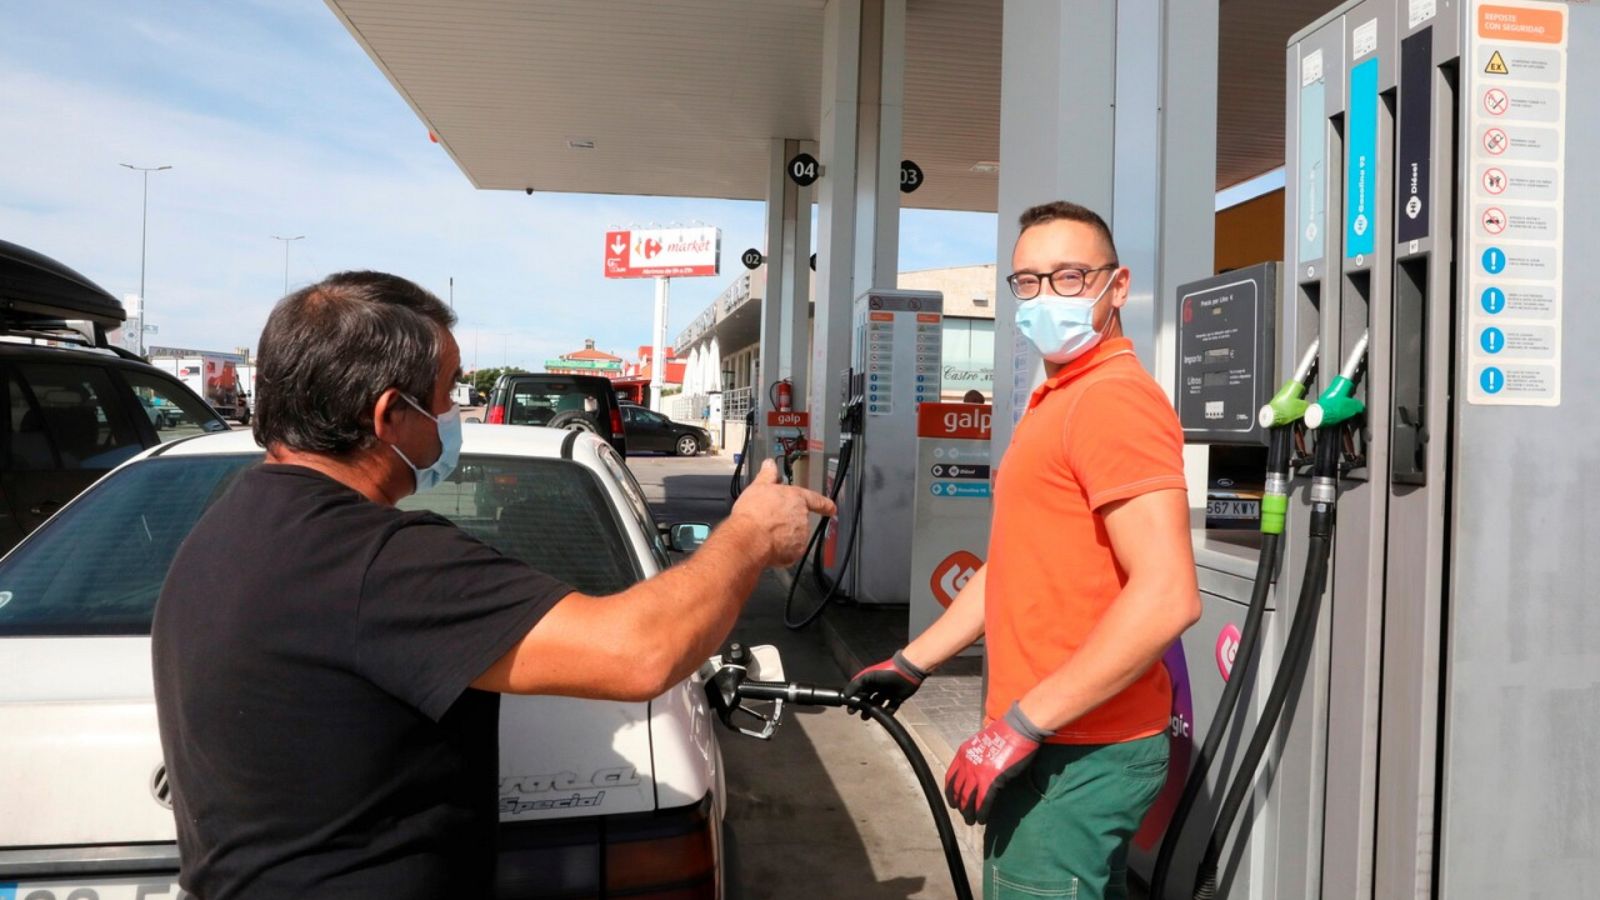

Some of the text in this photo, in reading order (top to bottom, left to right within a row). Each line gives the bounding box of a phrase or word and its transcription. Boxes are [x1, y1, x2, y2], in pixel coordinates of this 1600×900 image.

[1484, 12, 1516, 22] REPOSTE
[1484, 22, 1546, 34] CON SEGURIDAD
[1490, 63, 1502, 71] EX
[793, 161, 815, 178] 04
[900, 168, 918, 185] 03
[1410, 162, 1418, 194] Diésel
[667, 239, 710, 254] market
[745, 253, 760, 265] 02
[1183, 354, 1202, 365] Importe
[943, 365, 979, 381] Castro
[1187, 376, 1202, 386] Litros
[778, 414, 801, 424] galp
[943, 408, 992, 434] galp
[1207, 501, 1256, 515] 567 KWY
[1169, 713, 1189, 738] gic
